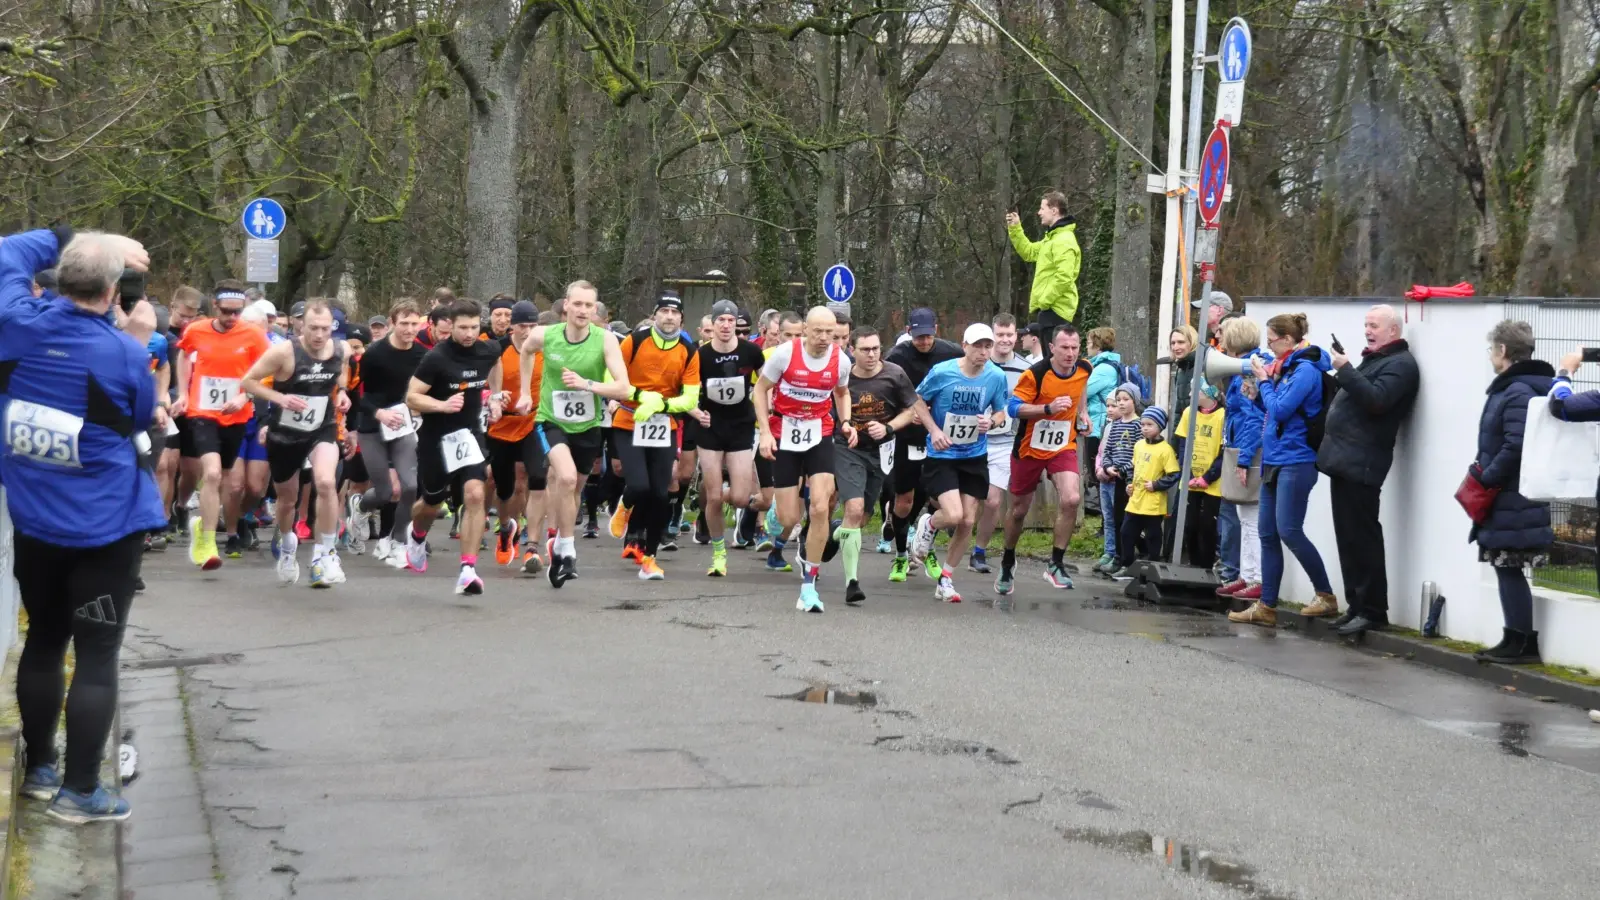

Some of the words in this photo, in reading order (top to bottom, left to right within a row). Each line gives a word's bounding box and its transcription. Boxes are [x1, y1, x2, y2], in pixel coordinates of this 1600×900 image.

[462, 370, 478, 378] RUN
[209, 388, 229, 405] 91
[718, 387, 736, 401] 19
[952, 392, 981, 404] RUN
[564, 401, 587, 418] 68
[951, 403, 978, 411] CREW
[640, 424, 668, 441] 122
[790, 428, 813, 445] 84
[949, 425, 977, 439] 137
[1038, 429, 1065, 446] 118
[12, 424, 71, 461] 895
[455, 442, 472, 461] 62
